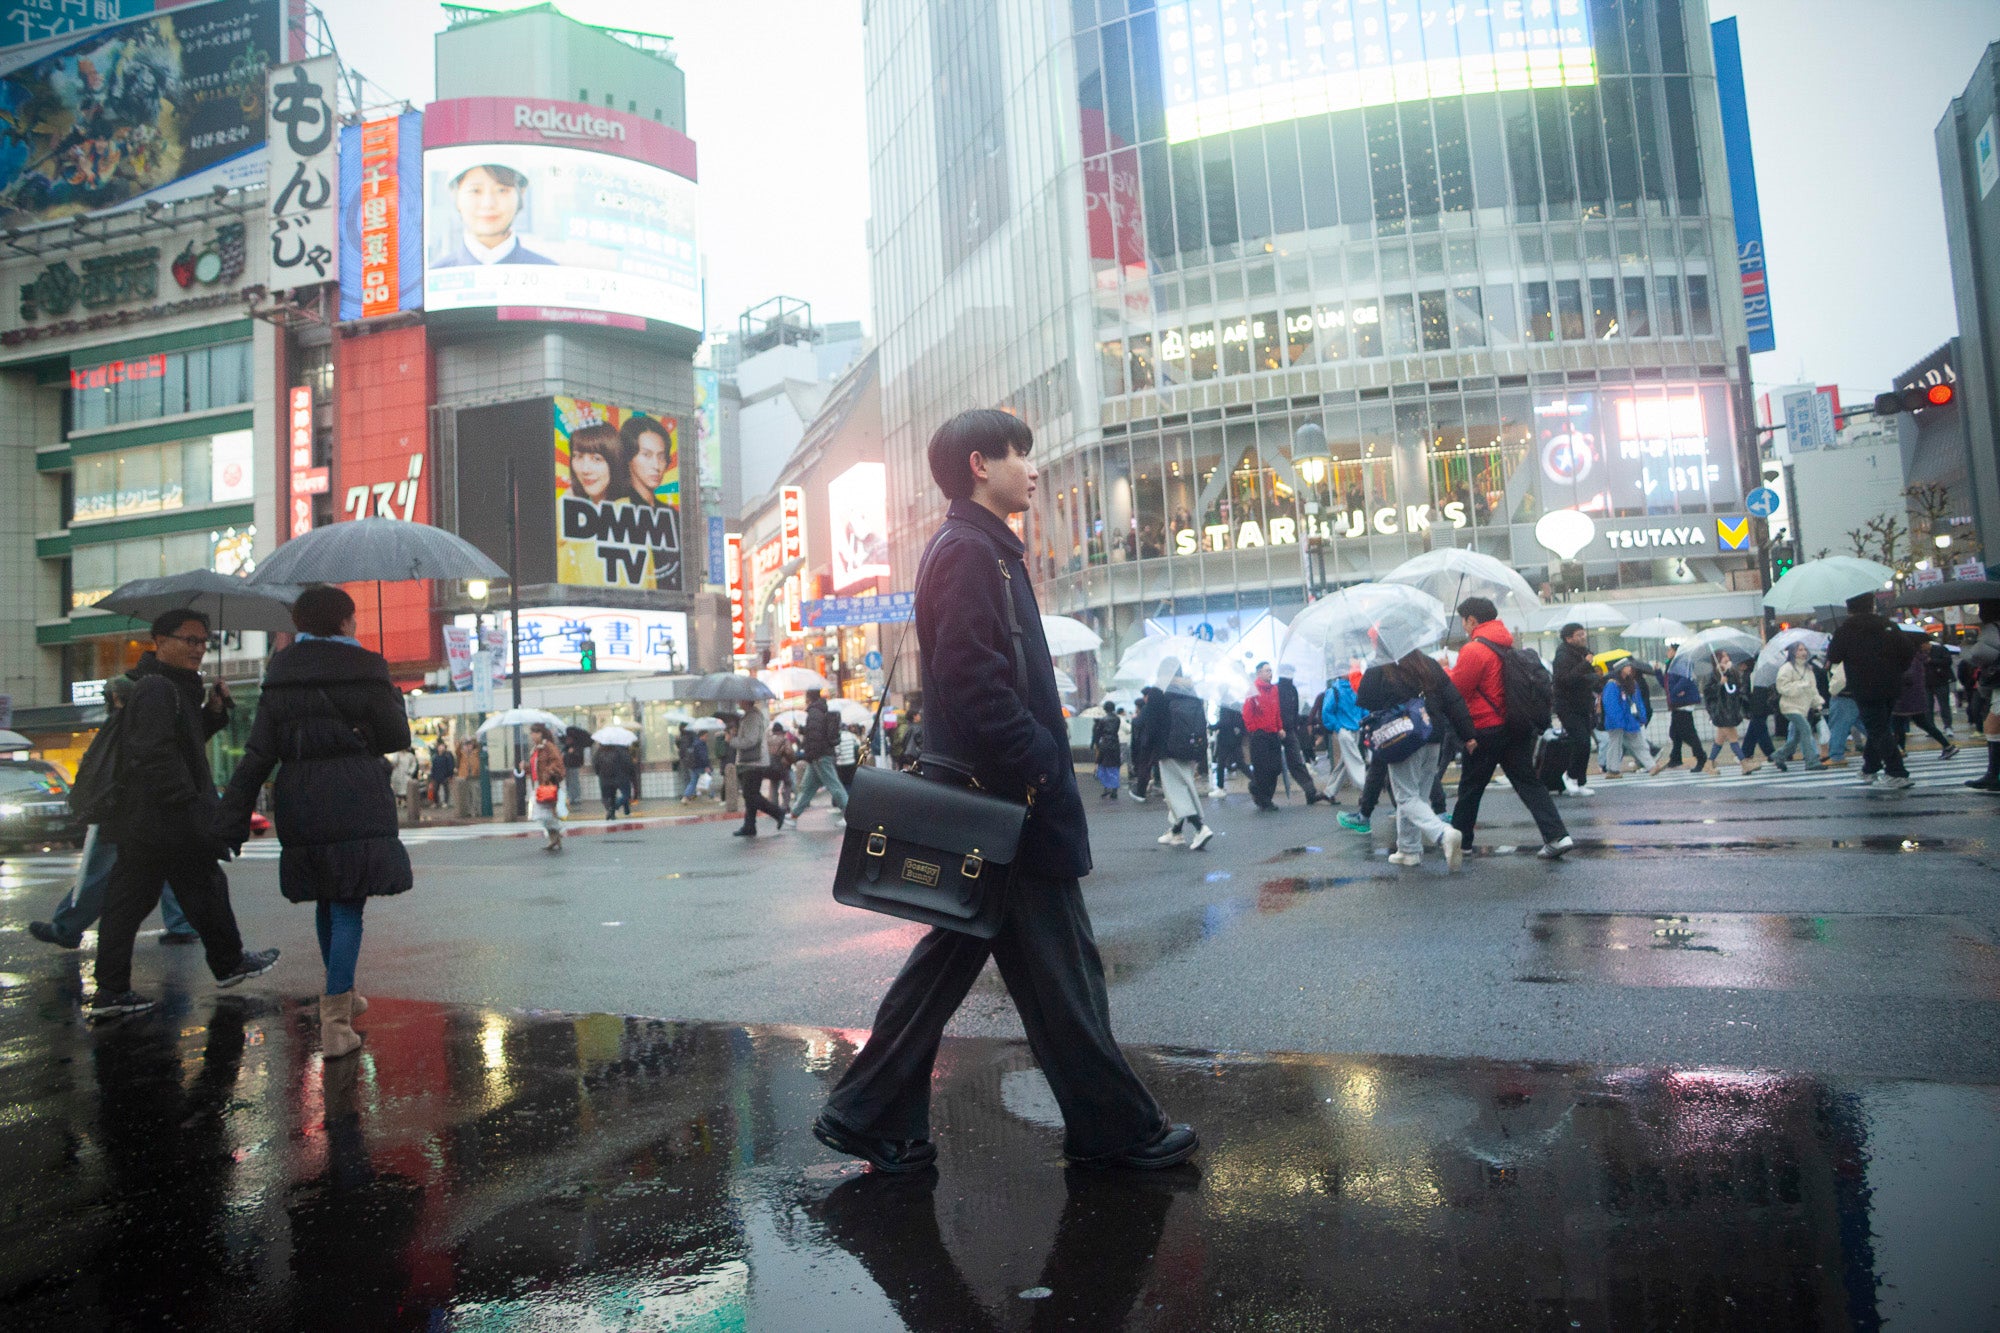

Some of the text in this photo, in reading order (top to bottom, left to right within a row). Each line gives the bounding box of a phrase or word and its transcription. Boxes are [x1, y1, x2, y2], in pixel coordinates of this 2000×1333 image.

[513, 104, 626, 142] Rakuten
[270, 64, 332, 278] もんじゃ
[361, 122, 391, 307] 三千里薬品
[1738, 240, 1770, 333] SEIBU
[1189, 306, 1379, 351] SHARE LOUNGE
[345, 454, 423, 522] クスリ
[563, 497, 677, 549] DMM
[1606, 527, 1706, 549] TSUTAYA
[598, 547, 647, 586] TV
[469, 620, 672, 656] 盛堂書店
